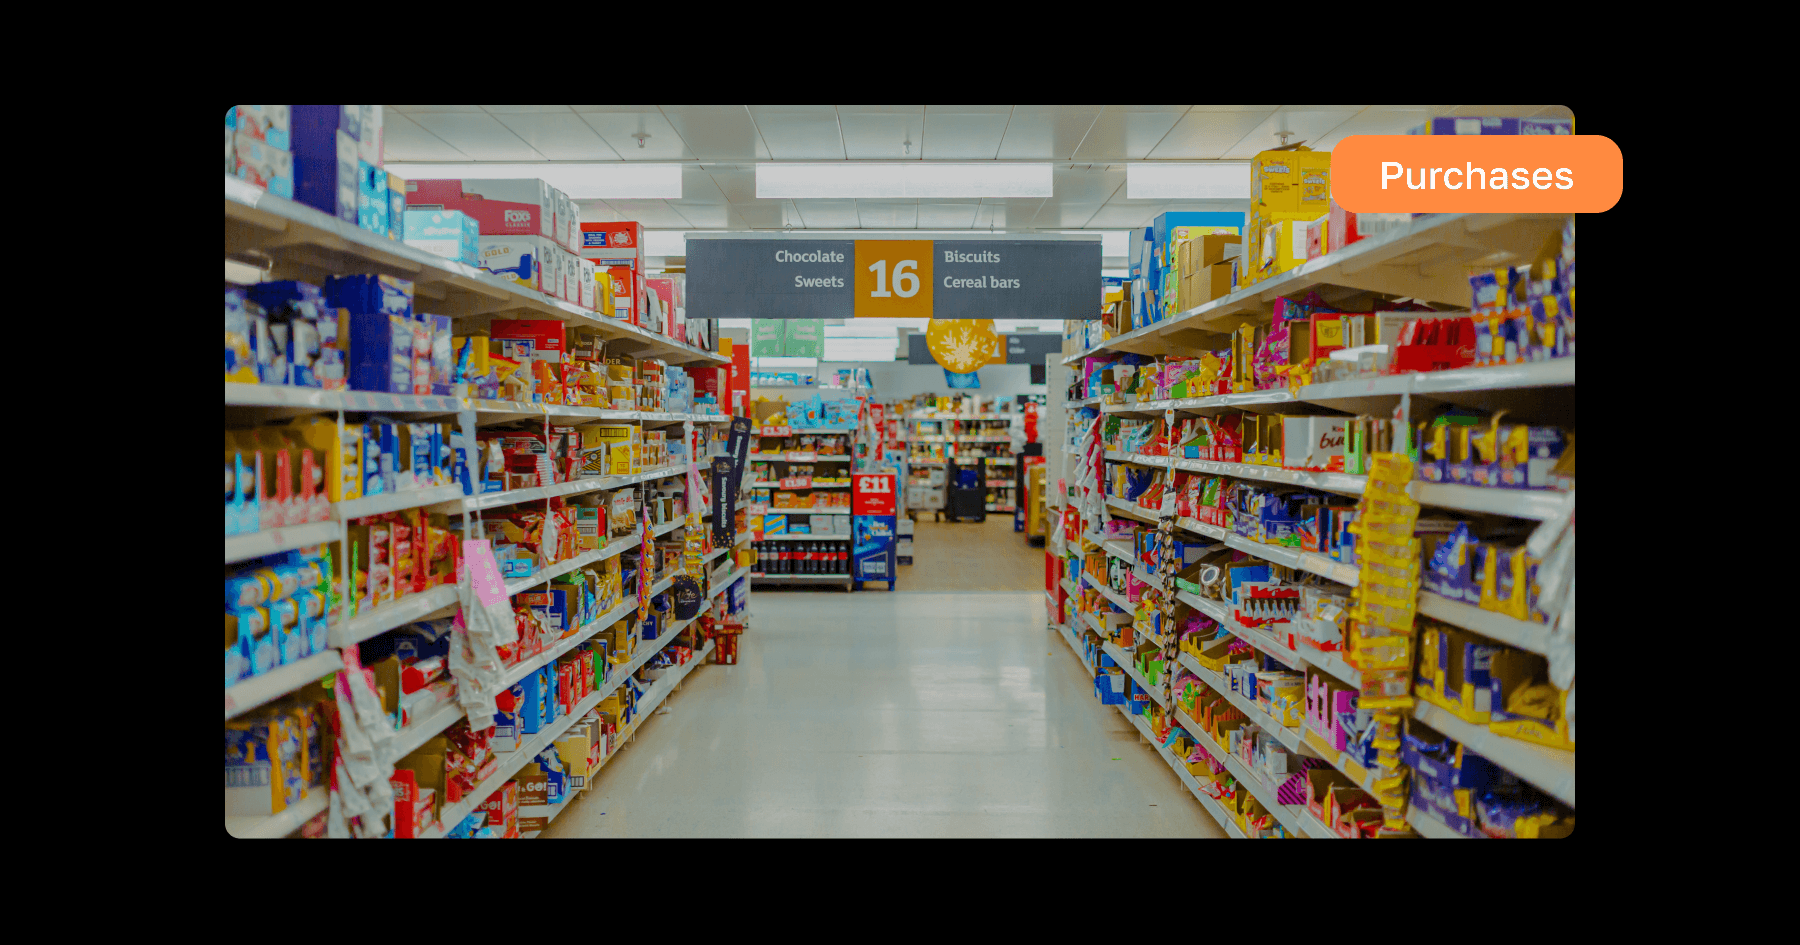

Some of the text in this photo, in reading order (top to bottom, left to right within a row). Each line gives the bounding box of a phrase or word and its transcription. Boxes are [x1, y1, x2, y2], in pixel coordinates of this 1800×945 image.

[484, 247, 510, 257] GOLD
[775, 249, 845, 263] Chocolate
[944, 249, 1001, 263] Biscuits
[794, 275, 845, 288] Sweets
[868, 259, 921, 299] 16
[943, 275, 1021, 289] Cereal bars
[858, 476, 892, 494] £11
